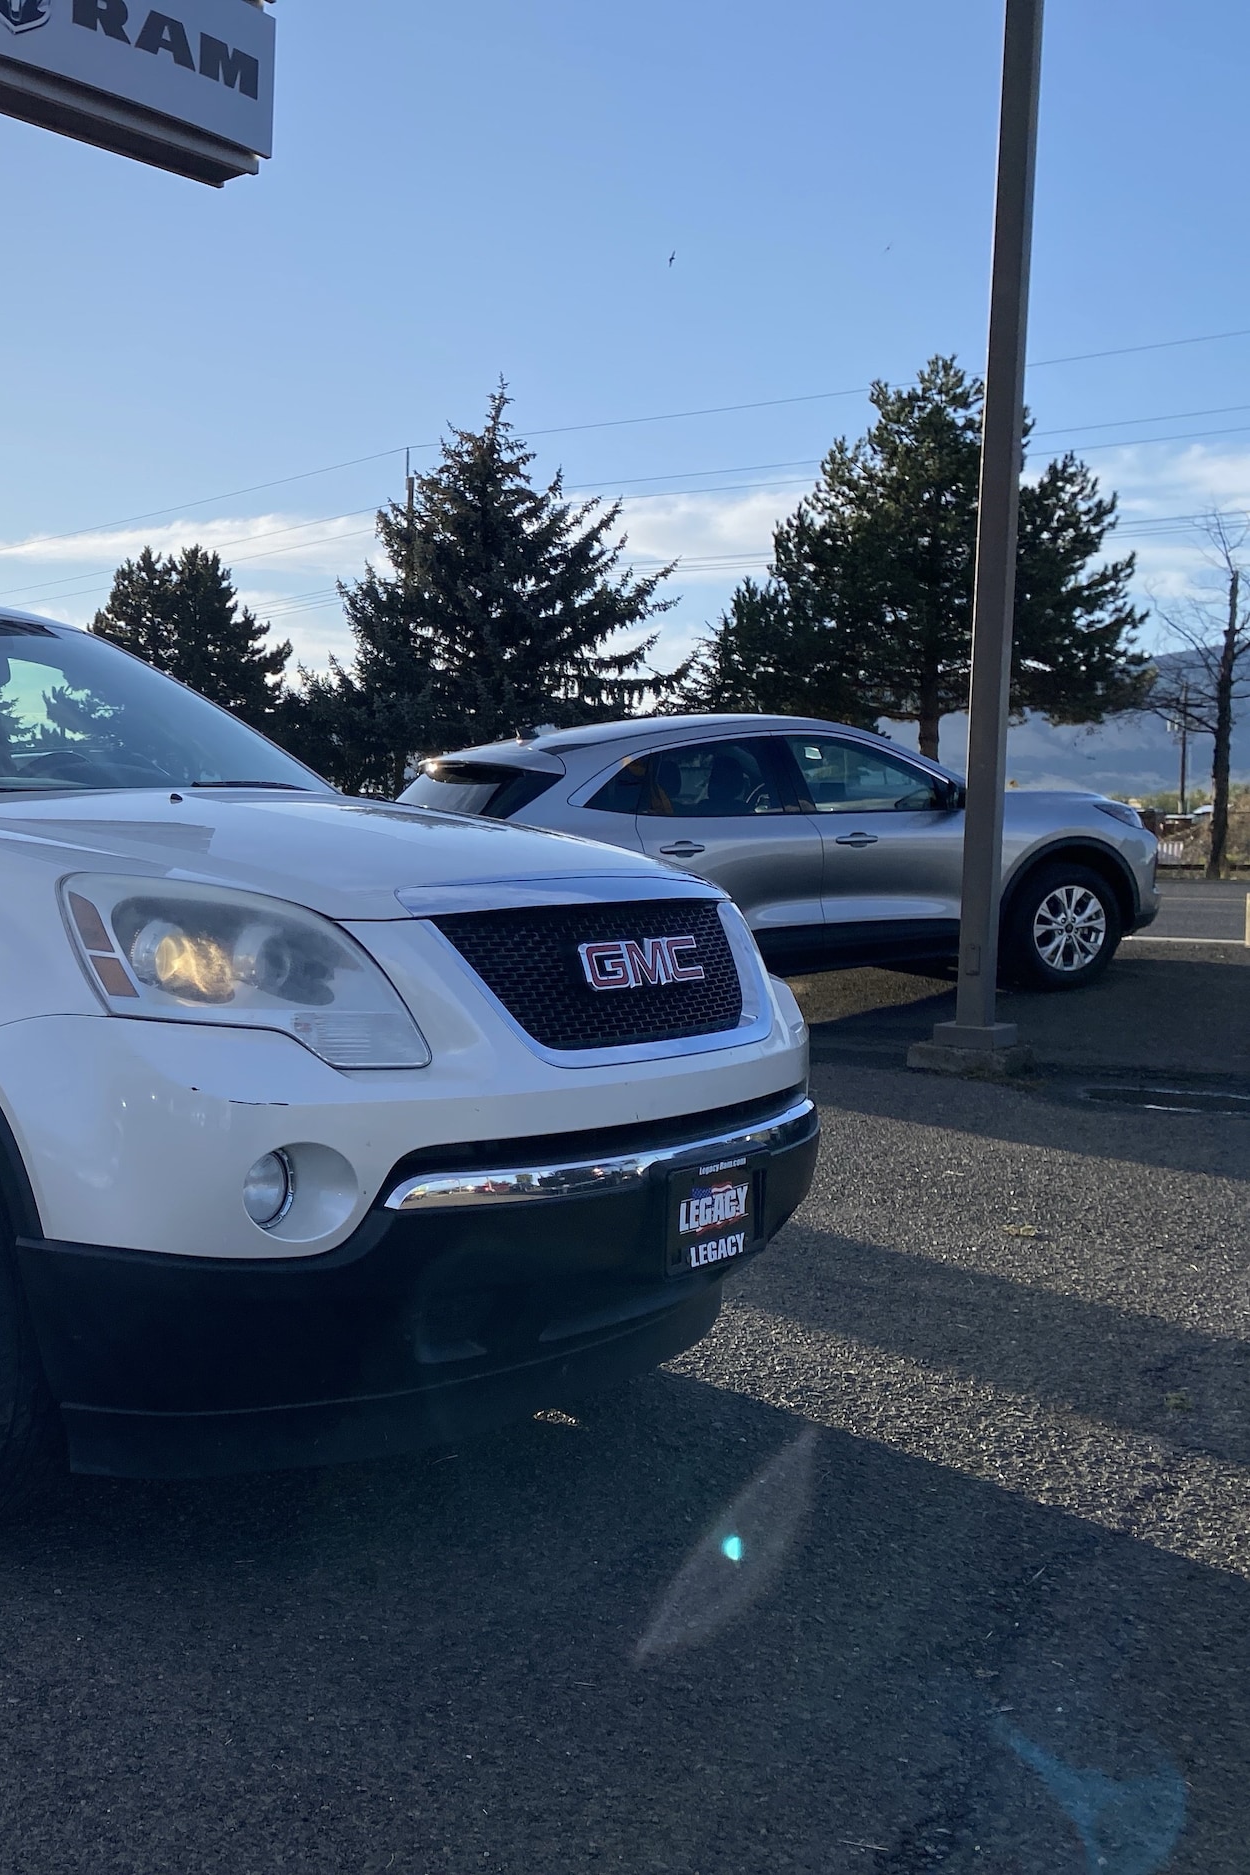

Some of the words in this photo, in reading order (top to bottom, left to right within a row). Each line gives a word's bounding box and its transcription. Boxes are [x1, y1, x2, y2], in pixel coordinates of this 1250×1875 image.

[73, 0, 259, 101] RAM
[578, 935, 705, 992] GMC
[679, 1185, 748, 1232] LEGACY
[690, 1232, 745, 1268] LEGACY
